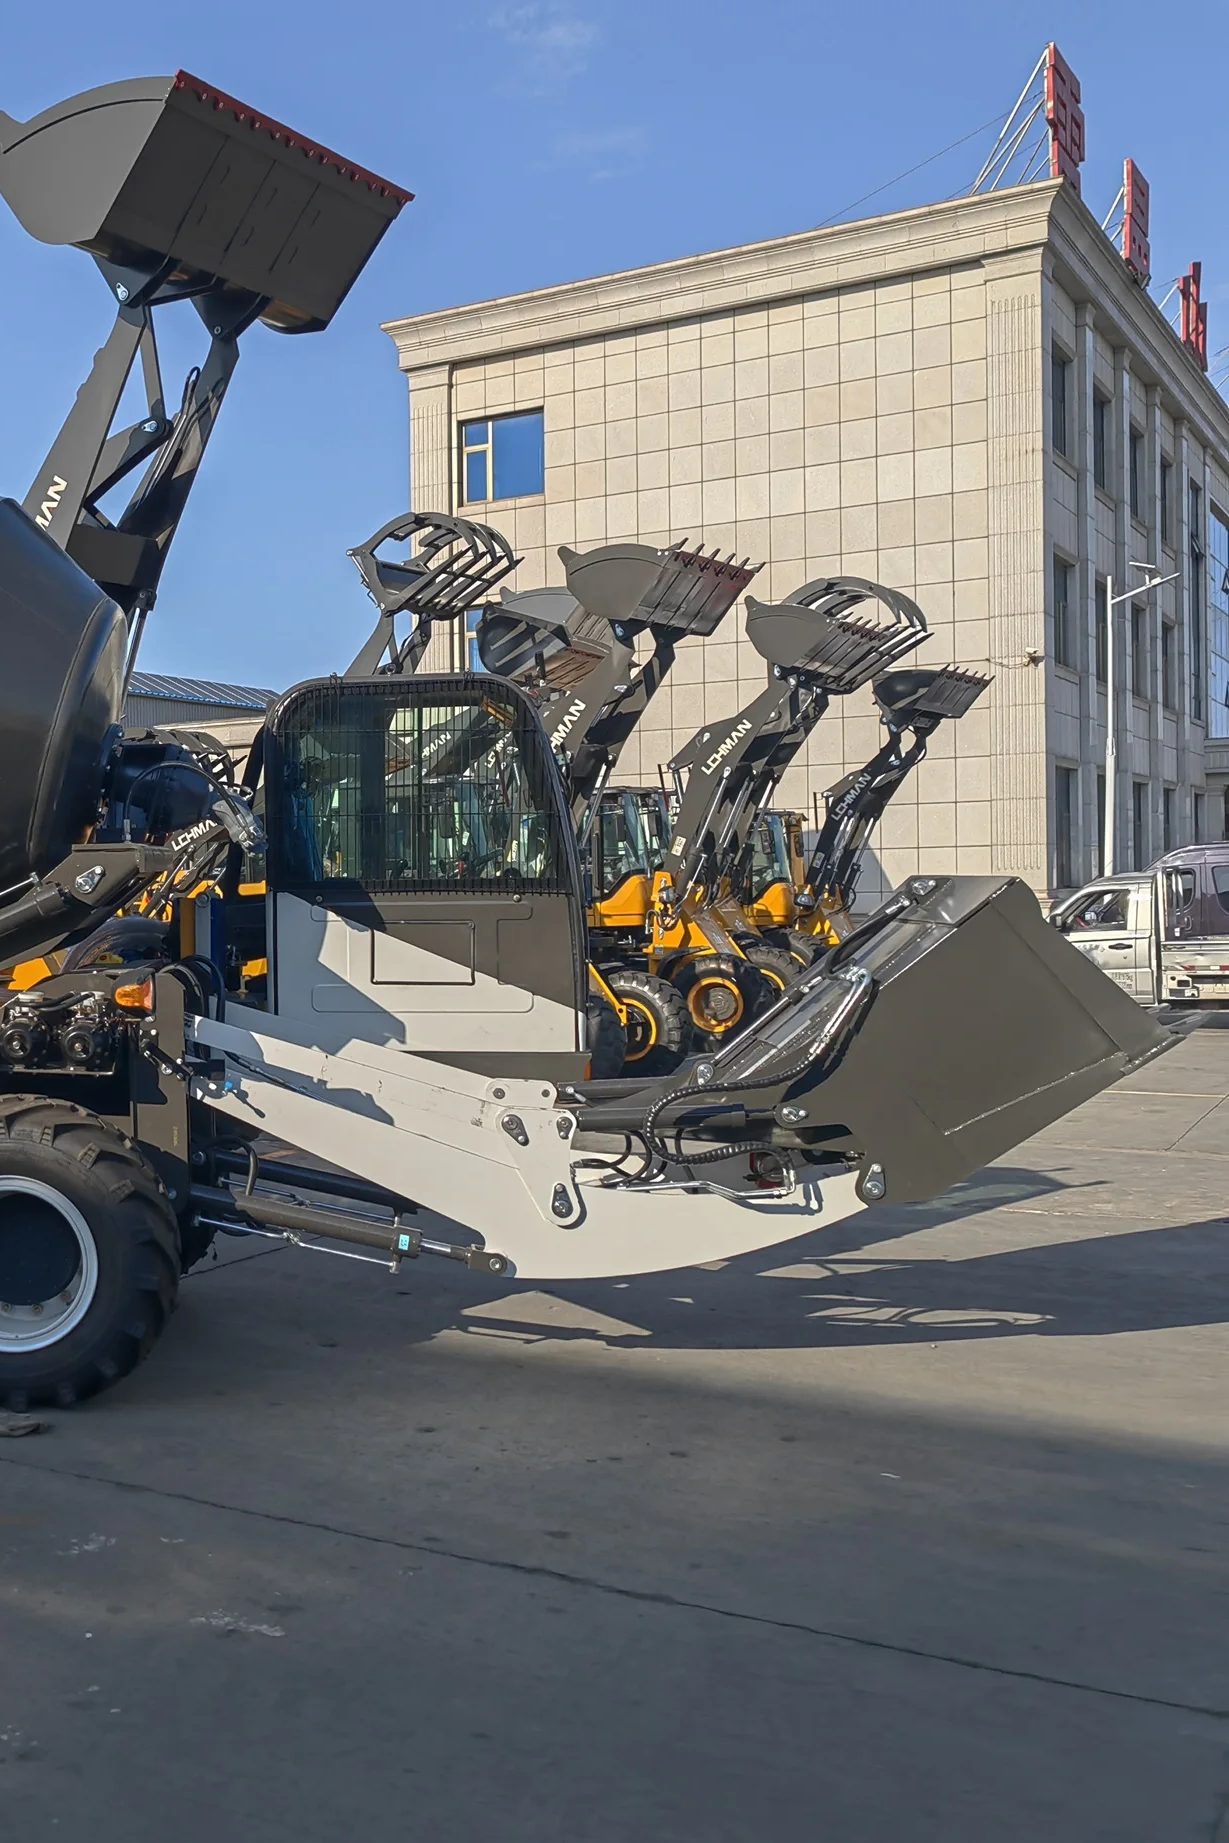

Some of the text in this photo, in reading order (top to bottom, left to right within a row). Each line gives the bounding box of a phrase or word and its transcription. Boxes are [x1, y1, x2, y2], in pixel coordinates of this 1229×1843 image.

[701, 719, 753, 775] LCHMAN
[831, 773, 872, 821] LCHMAN
[171, 819, 218, 852] LCHMA
